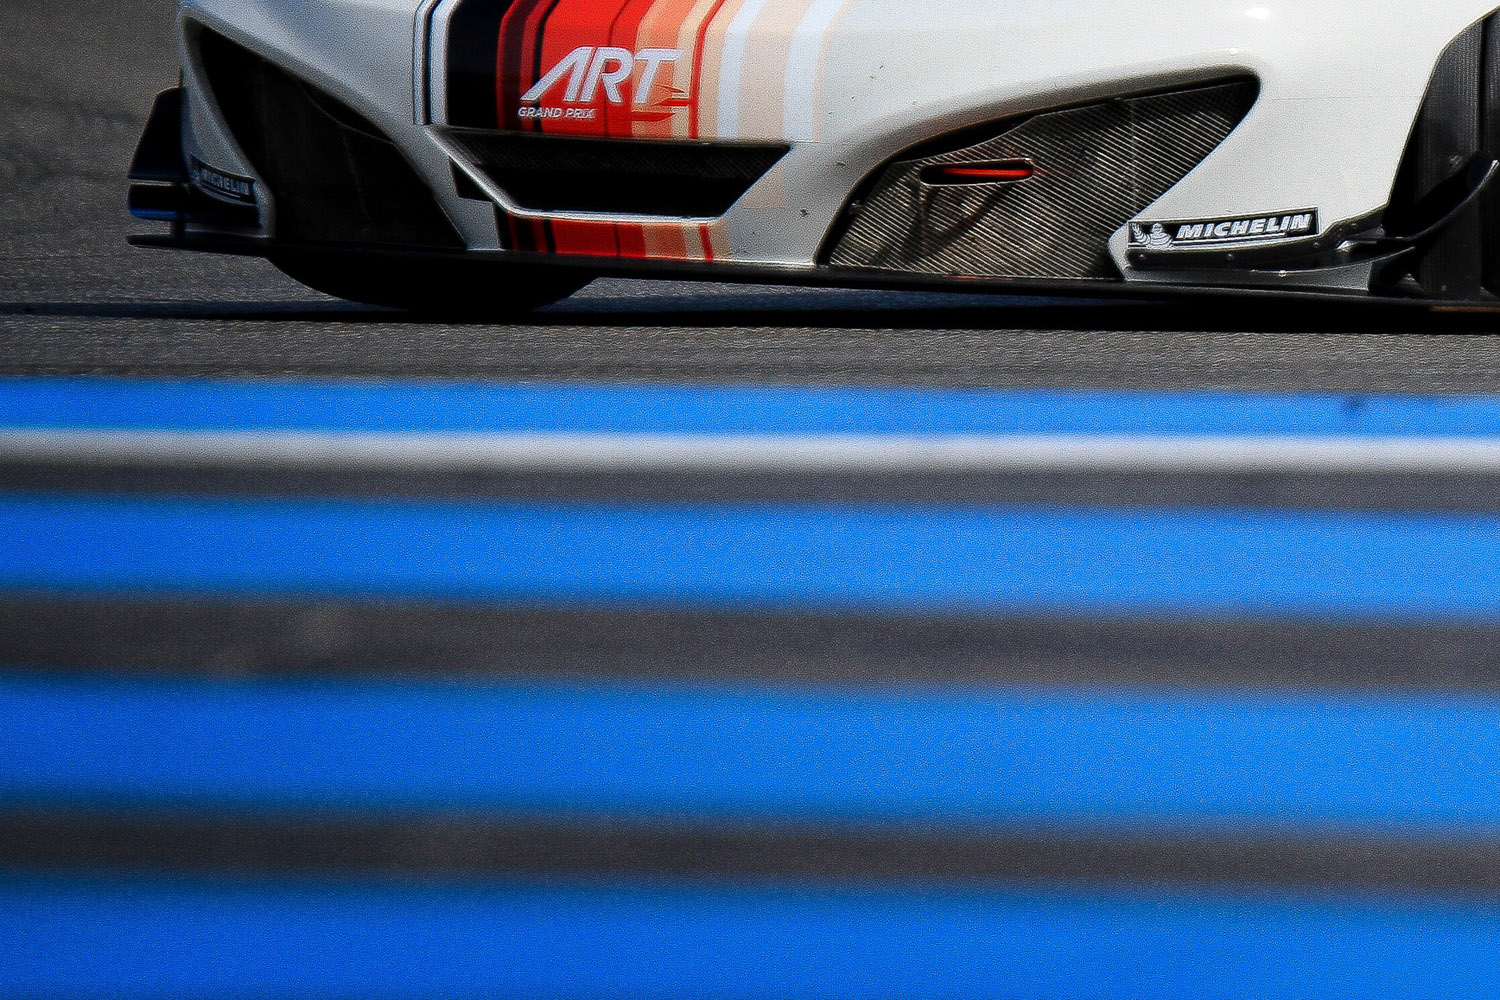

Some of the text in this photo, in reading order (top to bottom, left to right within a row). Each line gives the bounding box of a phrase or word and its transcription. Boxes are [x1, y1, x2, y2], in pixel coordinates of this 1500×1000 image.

[519, 46, 685, 105] ART
[517, 106, 563, 119] GRAND
[1176, 213, 1313, 240] MICHELIN
